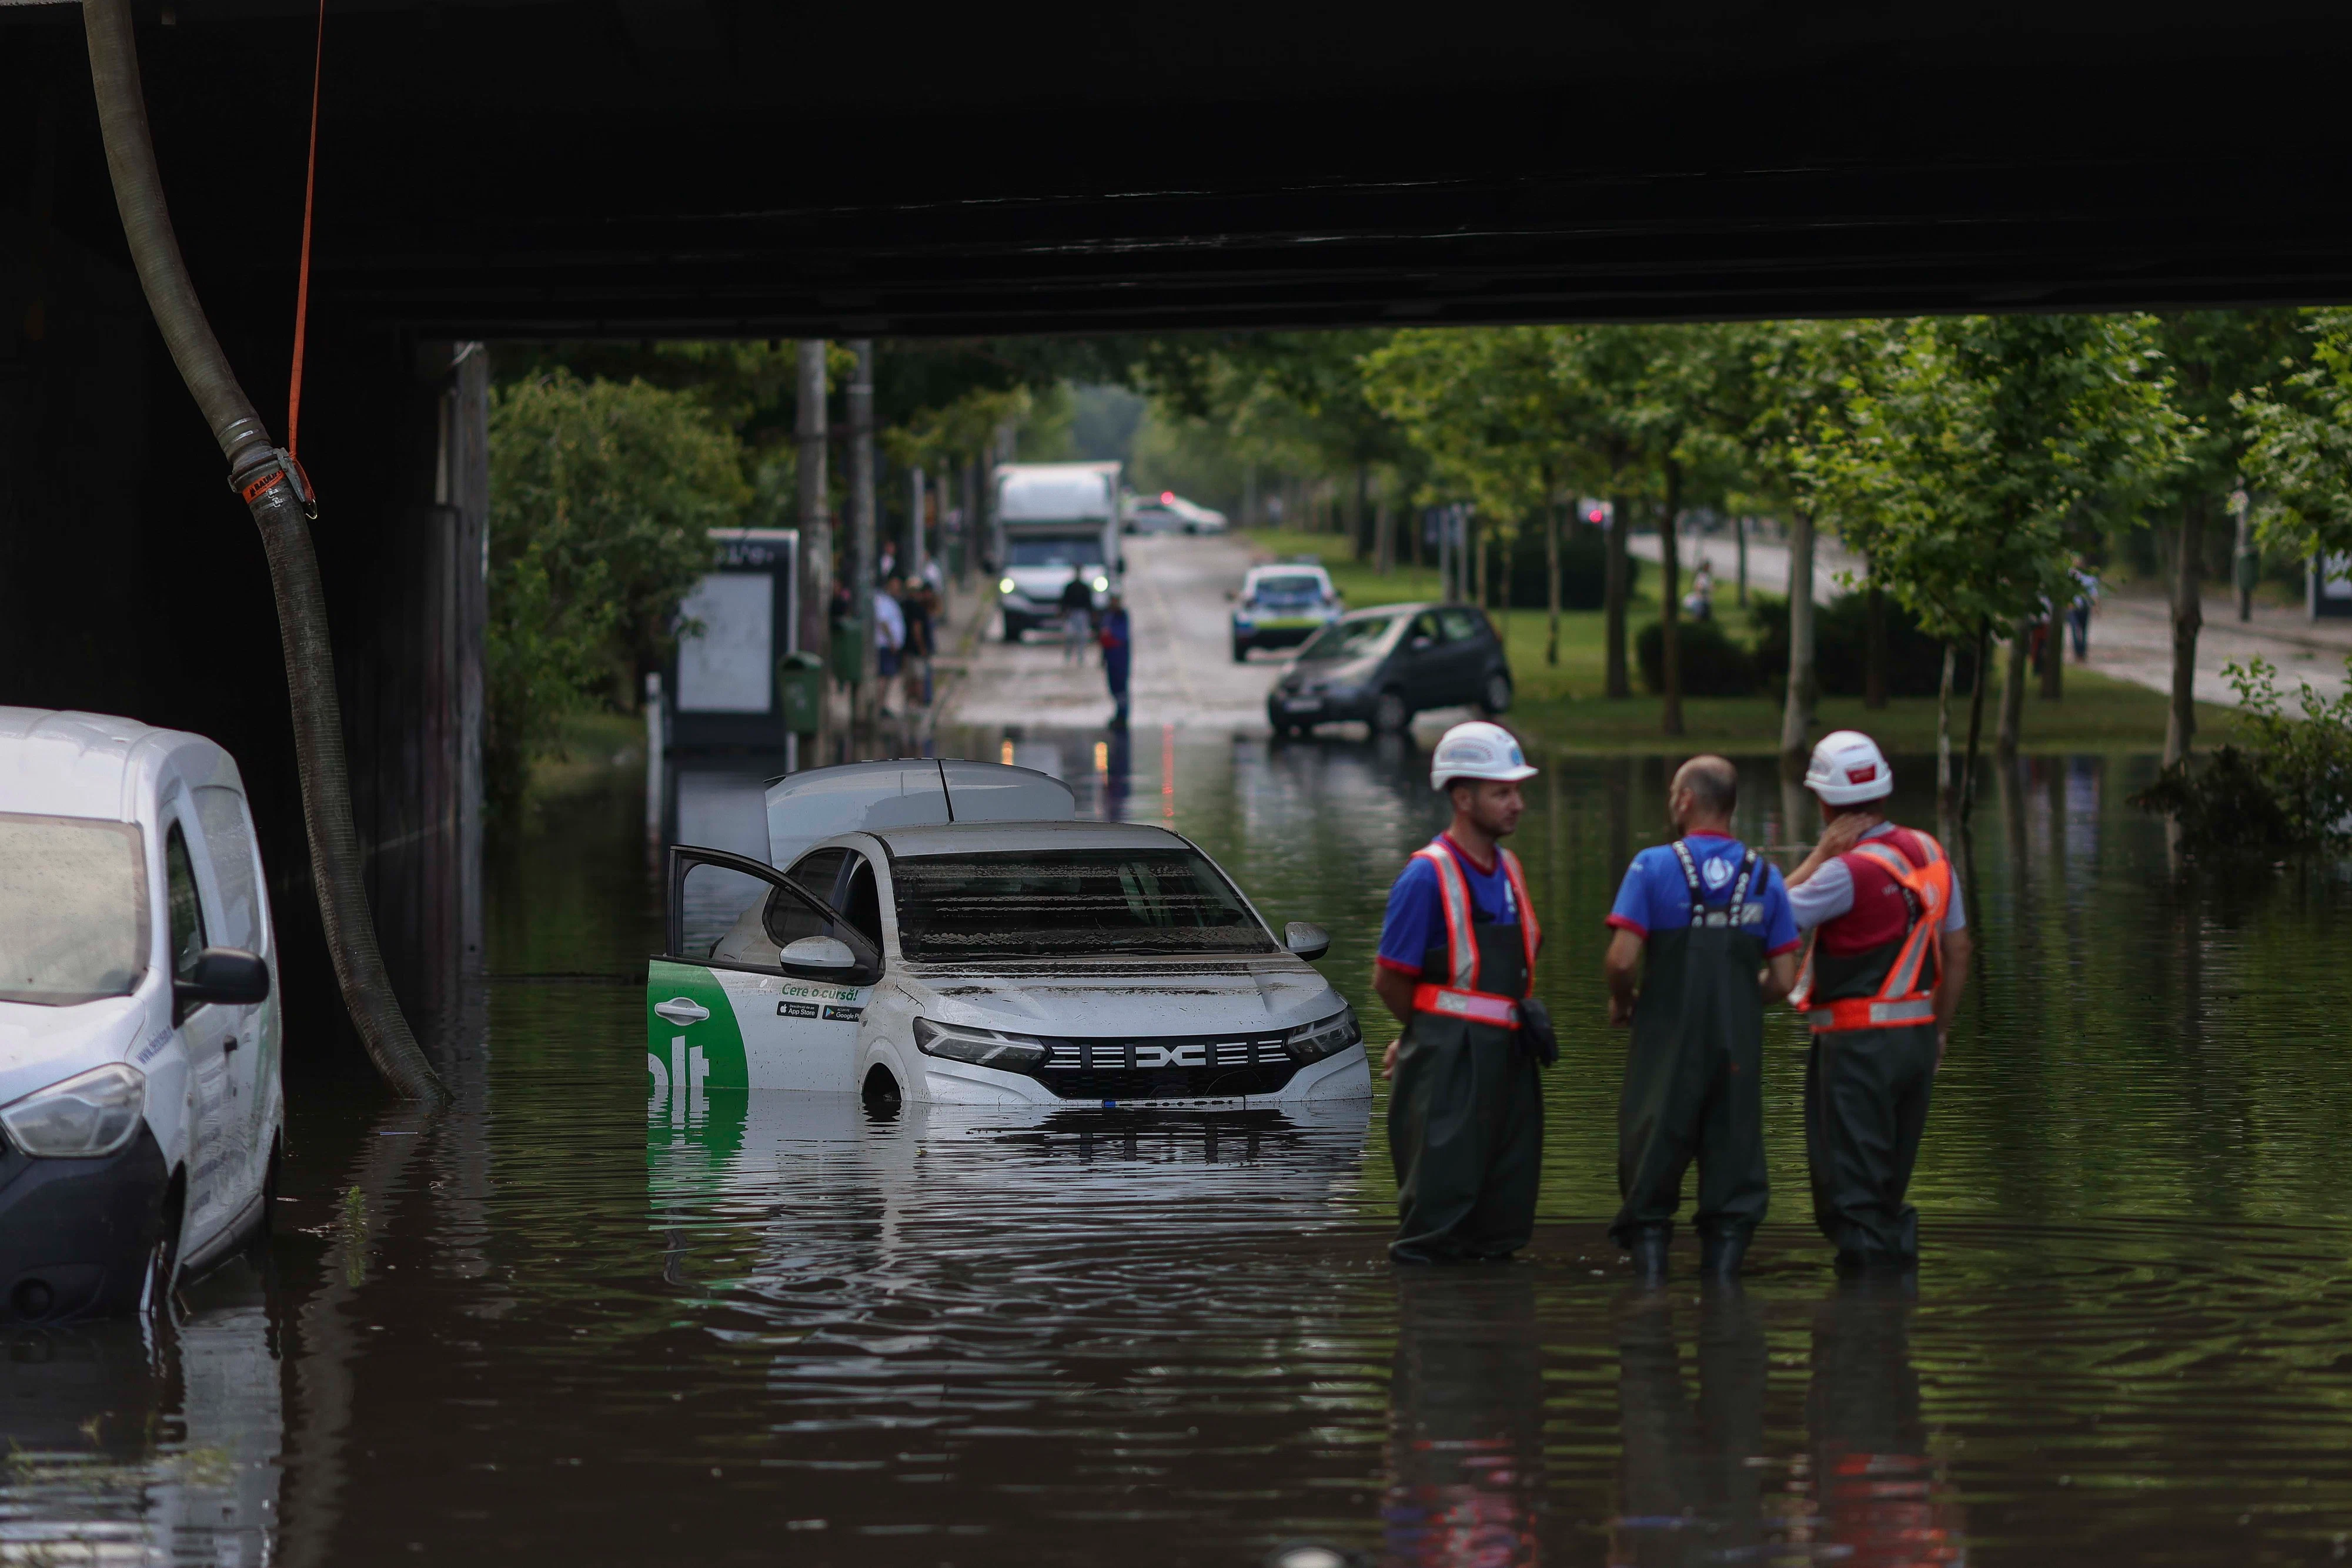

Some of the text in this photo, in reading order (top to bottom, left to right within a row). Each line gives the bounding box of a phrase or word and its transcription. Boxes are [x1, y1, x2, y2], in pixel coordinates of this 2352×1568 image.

[782, 983, 858, 1001] Cere o cursă!
